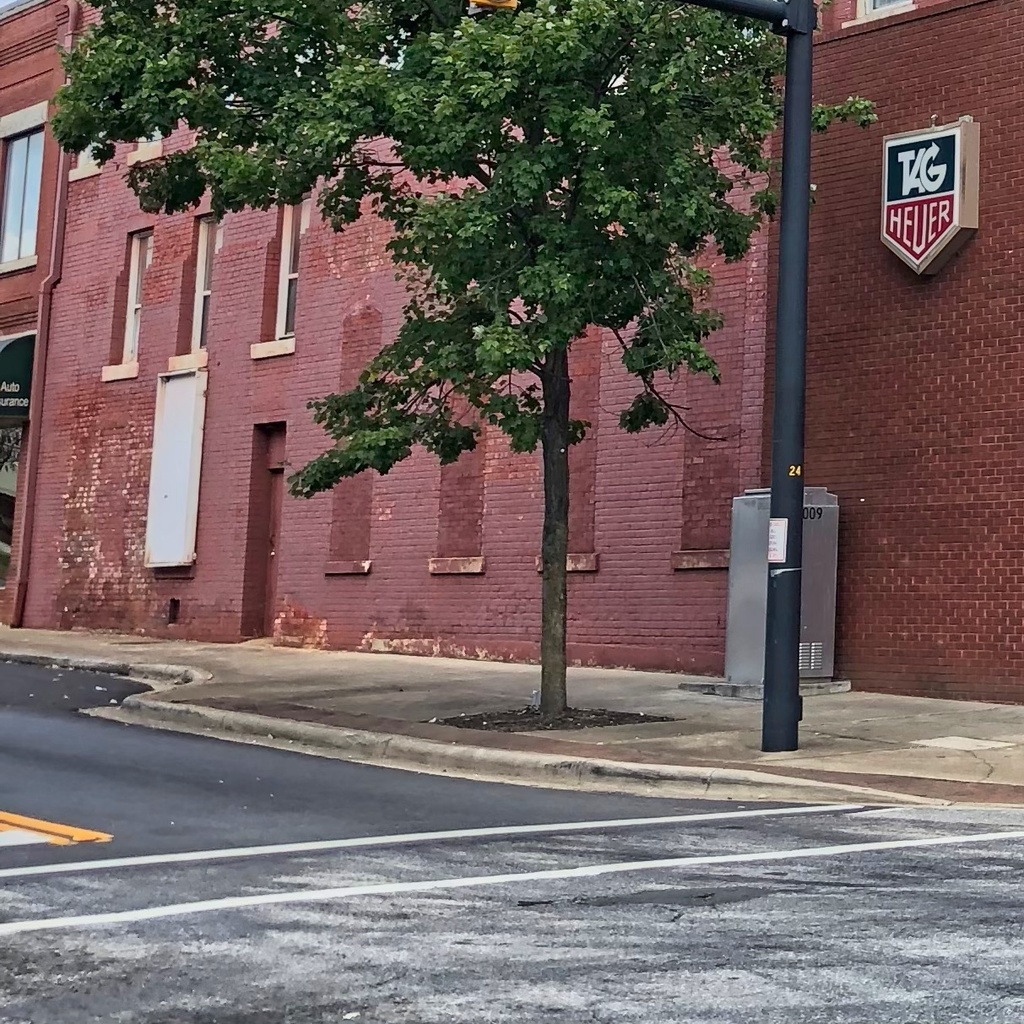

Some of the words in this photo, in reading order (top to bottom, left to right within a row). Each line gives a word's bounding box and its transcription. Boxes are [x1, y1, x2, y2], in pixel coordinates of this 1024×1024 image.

[898, 141, 947, 196] TAG
[889, 199, 950, 255] HEUER
[0, 380, 20, 393] Auto
[788, 465, 801, 476] 24
